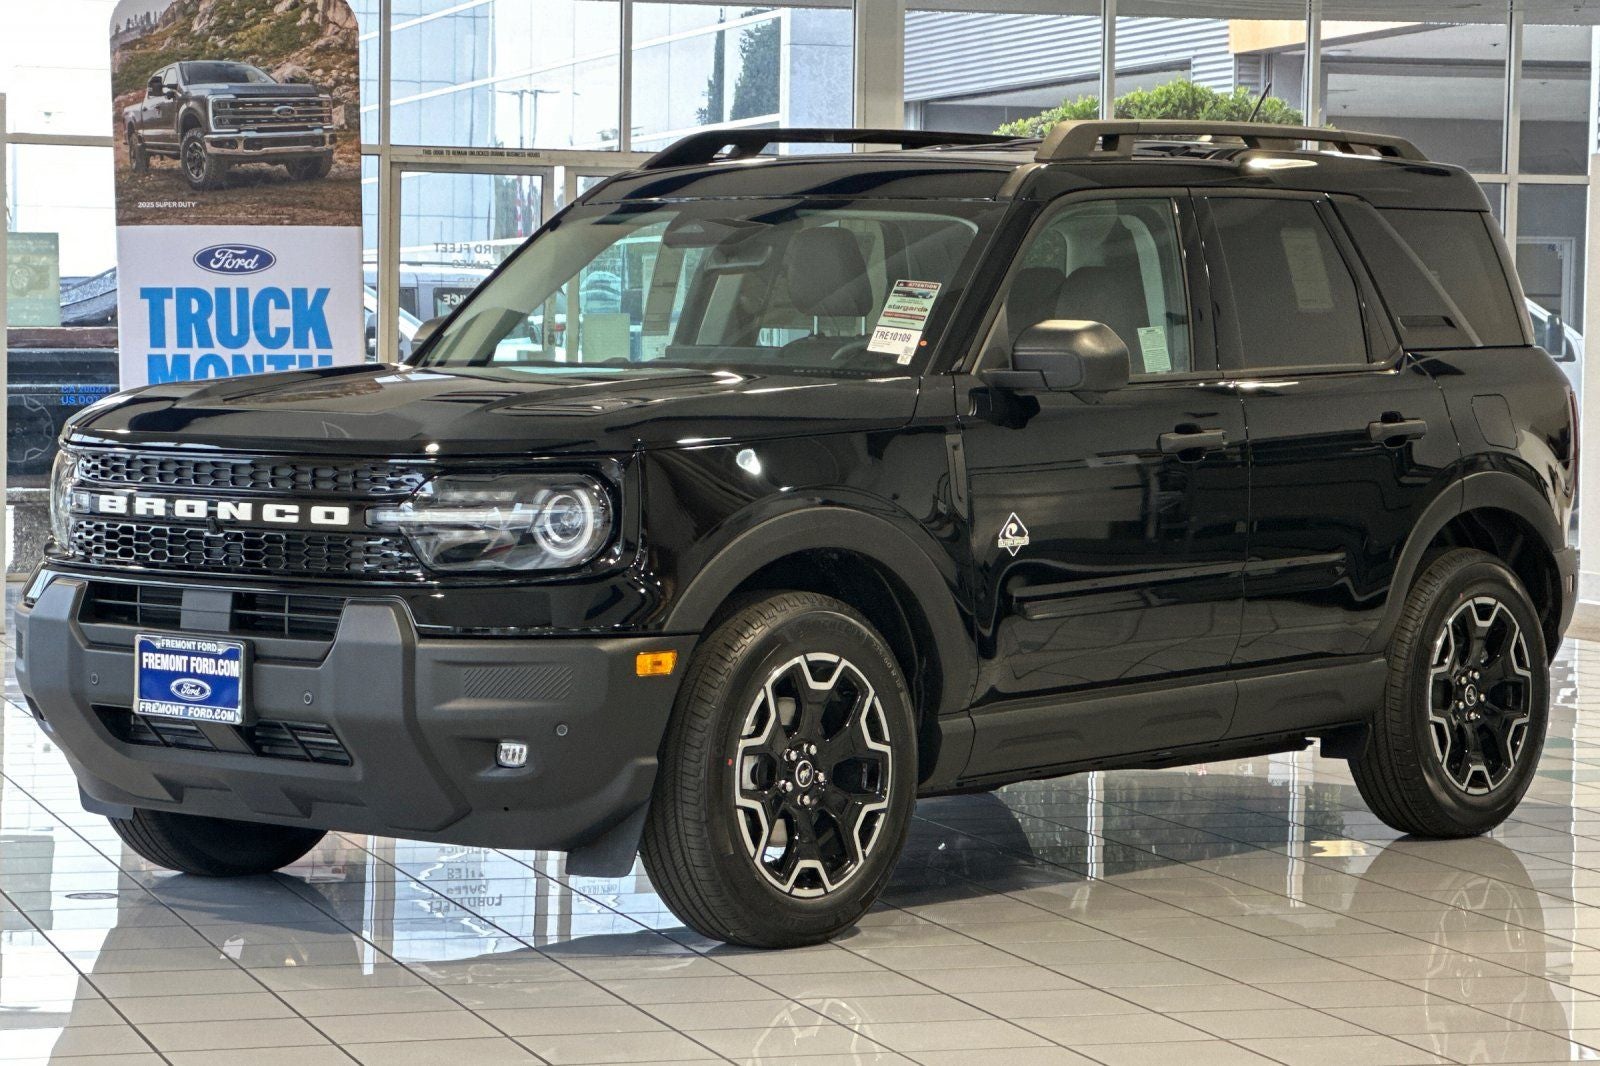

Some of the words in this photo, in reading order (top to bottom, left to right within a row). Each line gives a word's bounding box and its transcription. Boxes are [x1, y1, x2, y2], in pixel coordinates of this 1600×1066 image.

[209, 247, 260, 271] Ford
[140, 287, 333, 349] TRUCK
[876, 331, 912, 342] TRE10109
[62, 395, 75, 404] US
[99, 495, 350, 525] BRONCO
[161, 639, 196, 651] FREMONT
[197, 642, 217, 652] FORD
[142, 652, 188, 672] FREMONT
[190, 656, 240, 677] FORD.COM
[180, 682, 201, 696] Ford
[140, 701, 185, 716] FREMONT
[188, 707, 235, 722] FORD.COM
